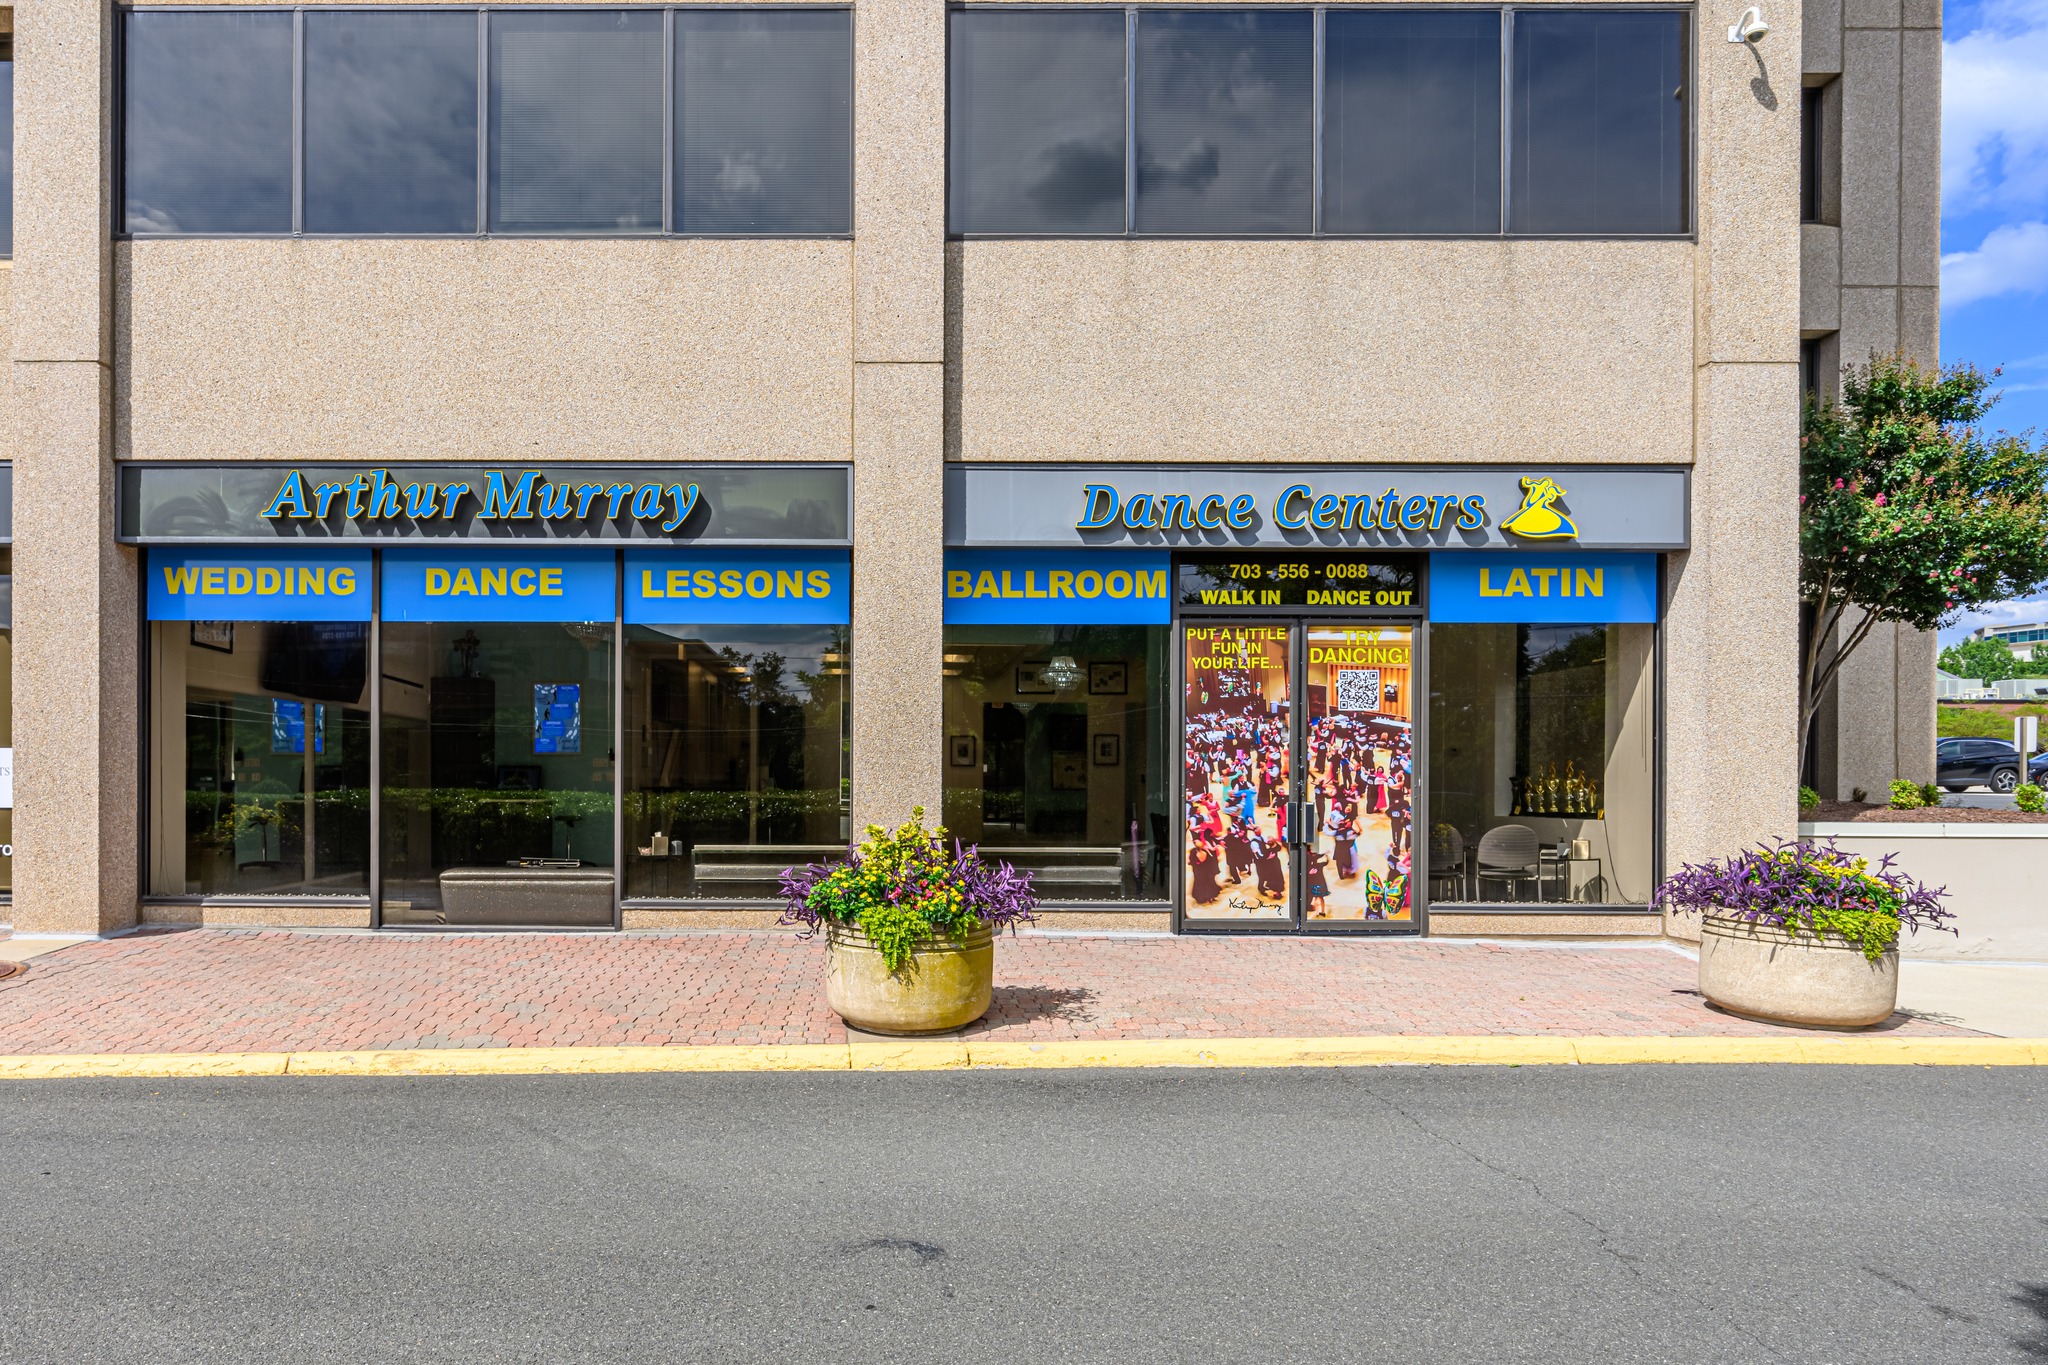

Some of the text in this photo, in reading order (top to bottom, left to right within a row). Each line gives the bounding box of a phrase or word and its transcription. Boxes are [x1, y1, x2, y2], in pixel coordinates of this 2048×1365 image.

[260, 468, 699, 532] Arthur Murray
[1076, 484, 1486, 530] Dance Centers
[164, 567, 355, 595] WEDDING
[425, 567, 563, 596] DANCE
[1230, 564, 1262, 579] 703
[1277, 564, 1309, 579] 556
[1326, 563, 1368, 579] 0088
[642, 570, 831, 598] LESSONS
[947, 570, 1167, 598] BALLROOM
[1479, 568, 1604, 597] LATIN
[1200, 590, 1413, 606] WALK IN DANCE OUT
[1186, 628, 1286, 640] PUT A LITTLE
[1342, 630, 1382, 646] TRY
[1211, 642, 1262, 654] FUN IN
[1310, 648, 1409, 664] DANCING!
[1192, 657, 1283, 669] YOUR LIFE...
